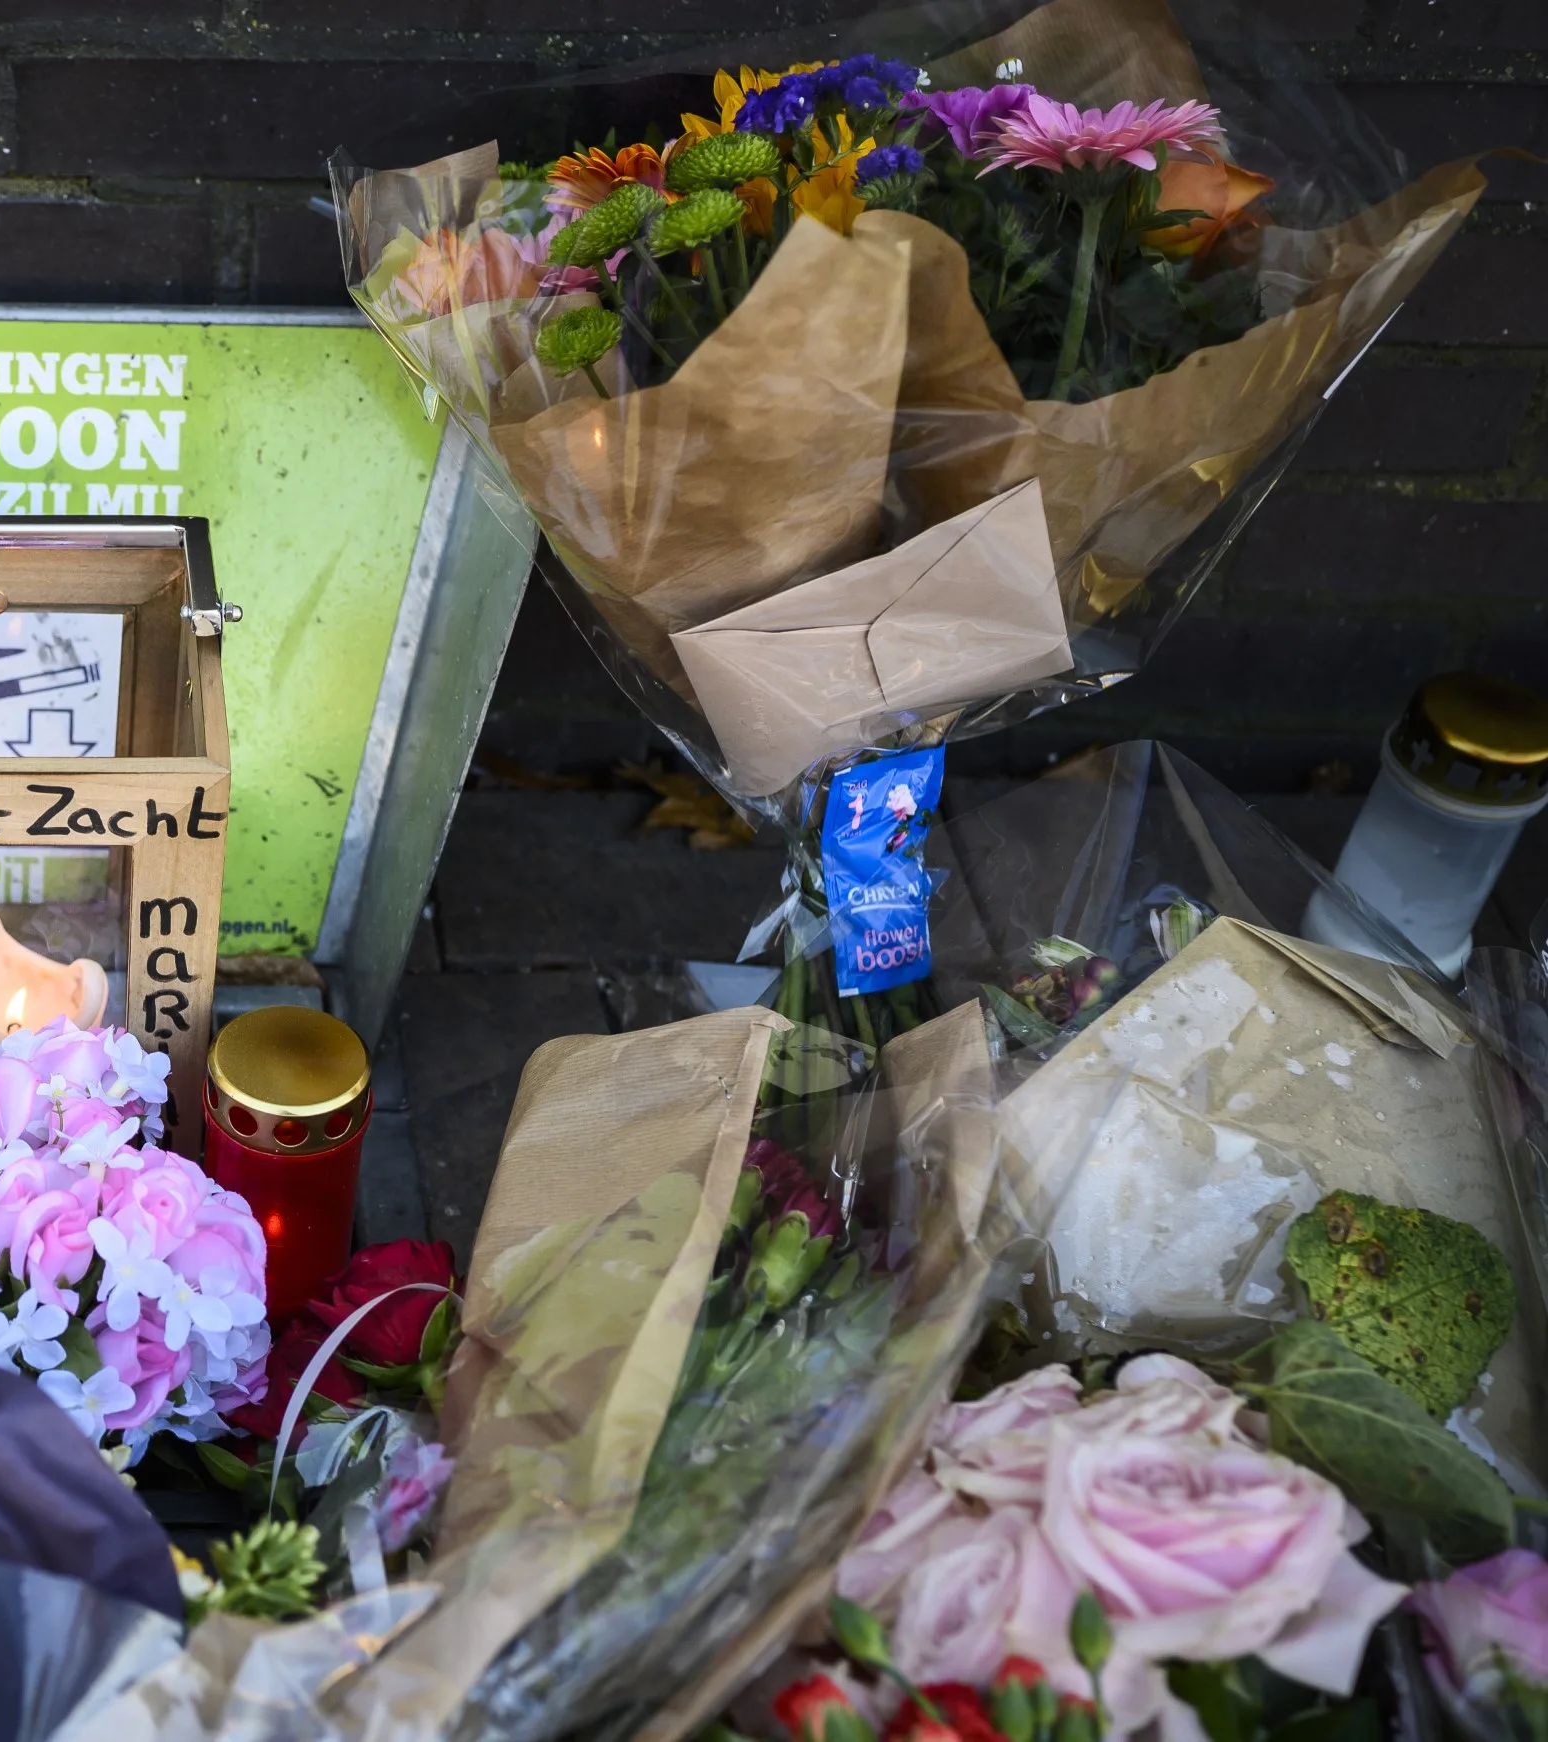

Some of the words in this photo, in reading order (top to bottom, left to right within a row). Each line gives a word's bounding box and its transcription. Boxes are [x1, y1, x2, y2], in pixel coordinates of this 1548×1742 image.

[25, 784, 228, 839] Zacht
[856, 935, 926, 973] boost
[864, 924, 919, 947] flower
